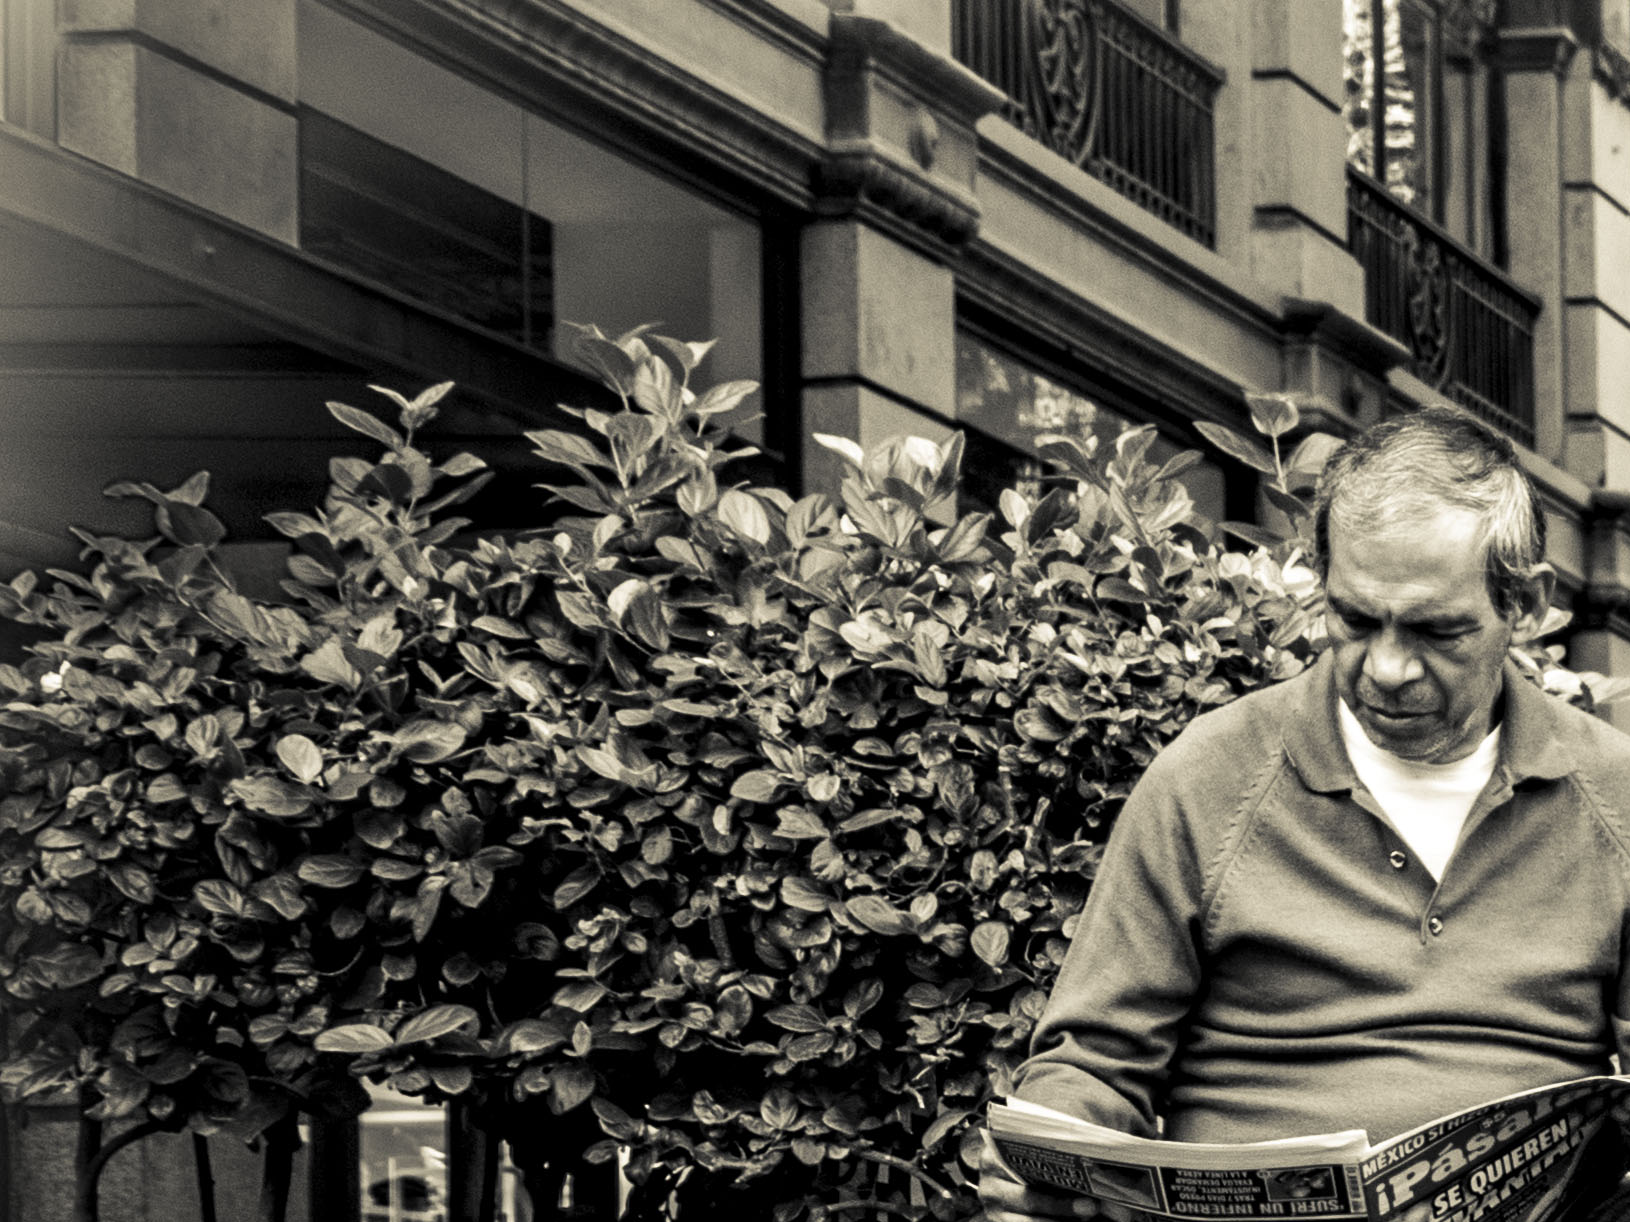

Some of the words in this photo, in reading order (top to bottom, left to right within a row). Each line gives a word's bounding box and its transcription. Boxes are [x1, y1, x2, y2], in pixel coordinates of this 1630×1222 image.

[1361, 1134, 1426, 1179] MÉXICO
[1432, 1183, 1463, 1217] SE
[1469, 1117, 1568, 1195] QUIEREN
[1259, 1202, 1284, 1214] UN
